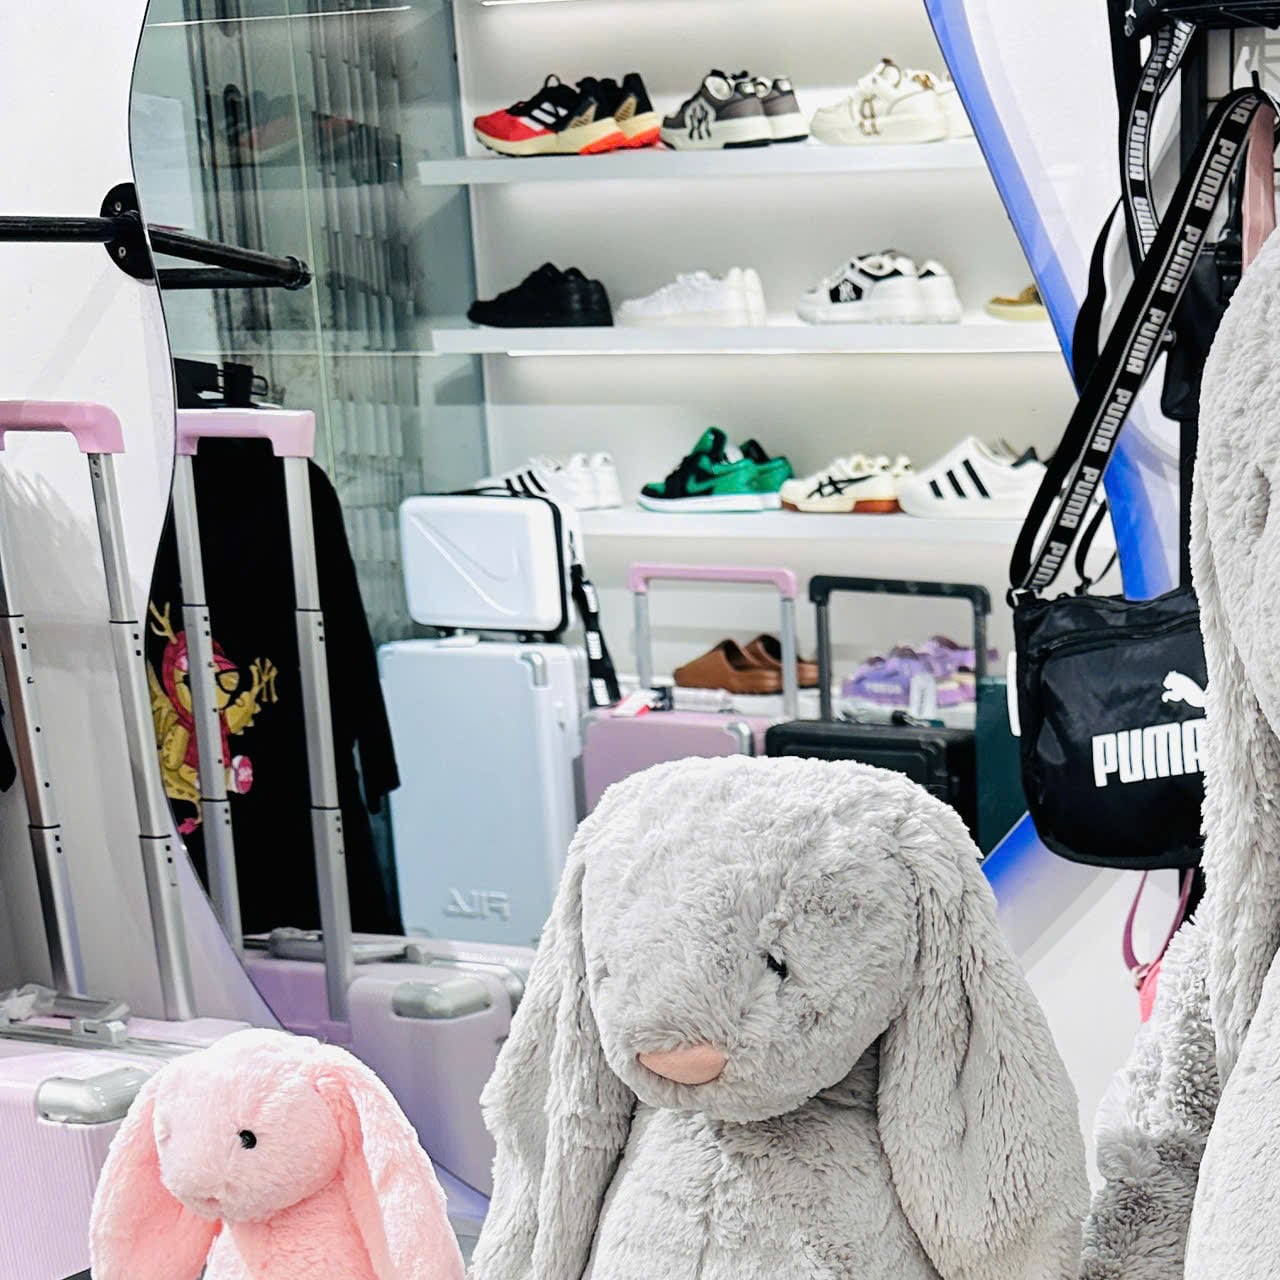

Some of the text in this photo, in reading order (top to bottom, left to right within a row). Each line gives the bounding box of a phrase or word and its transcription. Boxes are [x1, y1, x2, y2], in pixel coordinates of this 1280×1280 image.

[1129, 109, 1149, 181] PUMA
[1195, 138, 1238, 212] PUMA
[1161, 225, 1203, 293] PUMA
[1126, 307, 1167, 375] PUMA
[1091, 388, 1133, 453] PUMA
[1059, 465, 1100, 529] PUMA
[1028, 541, 1068, 595] PUM
